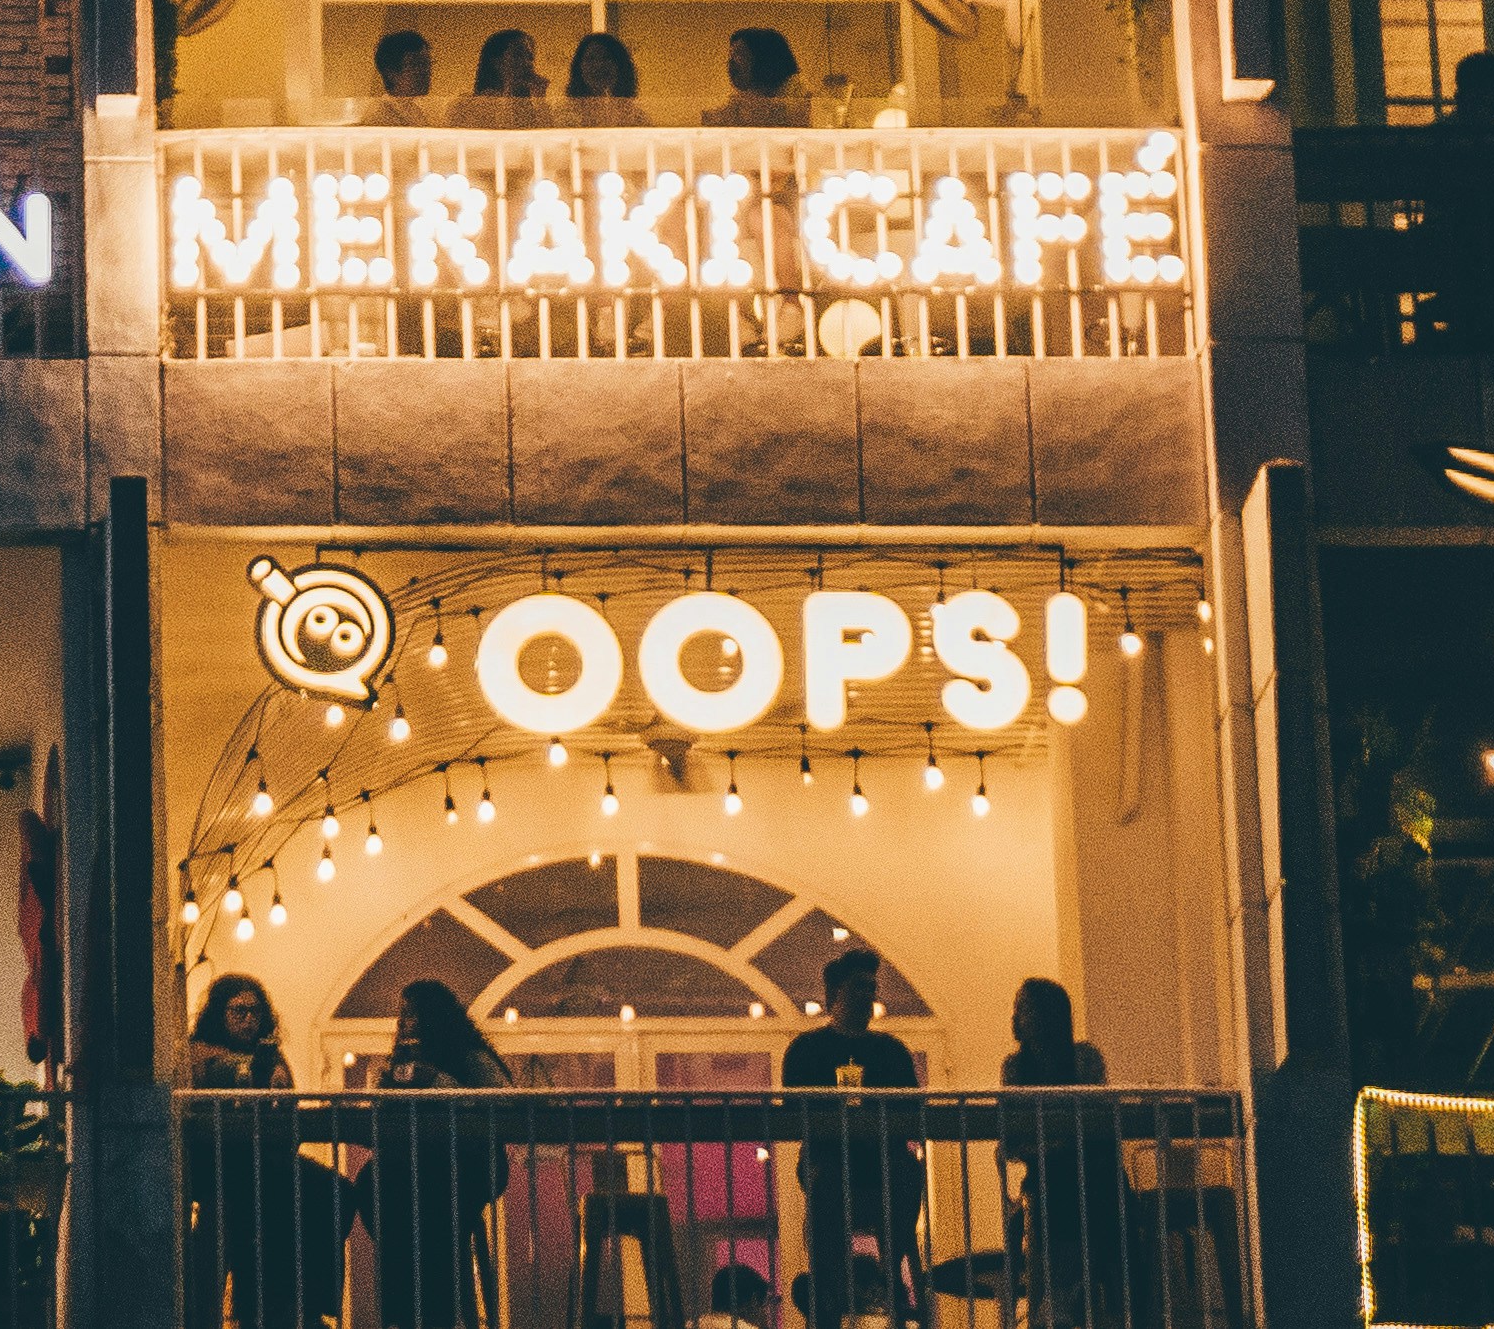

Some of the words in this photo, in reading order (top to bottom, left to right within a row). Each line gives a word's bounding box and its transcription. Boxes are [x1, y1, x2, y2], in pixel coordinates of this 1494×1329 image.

[172, 172, 754, 290] MERAKI
[802, 130, 1186, 286] CAFÉ
[474, 590, 1089, 734] OOPS!
